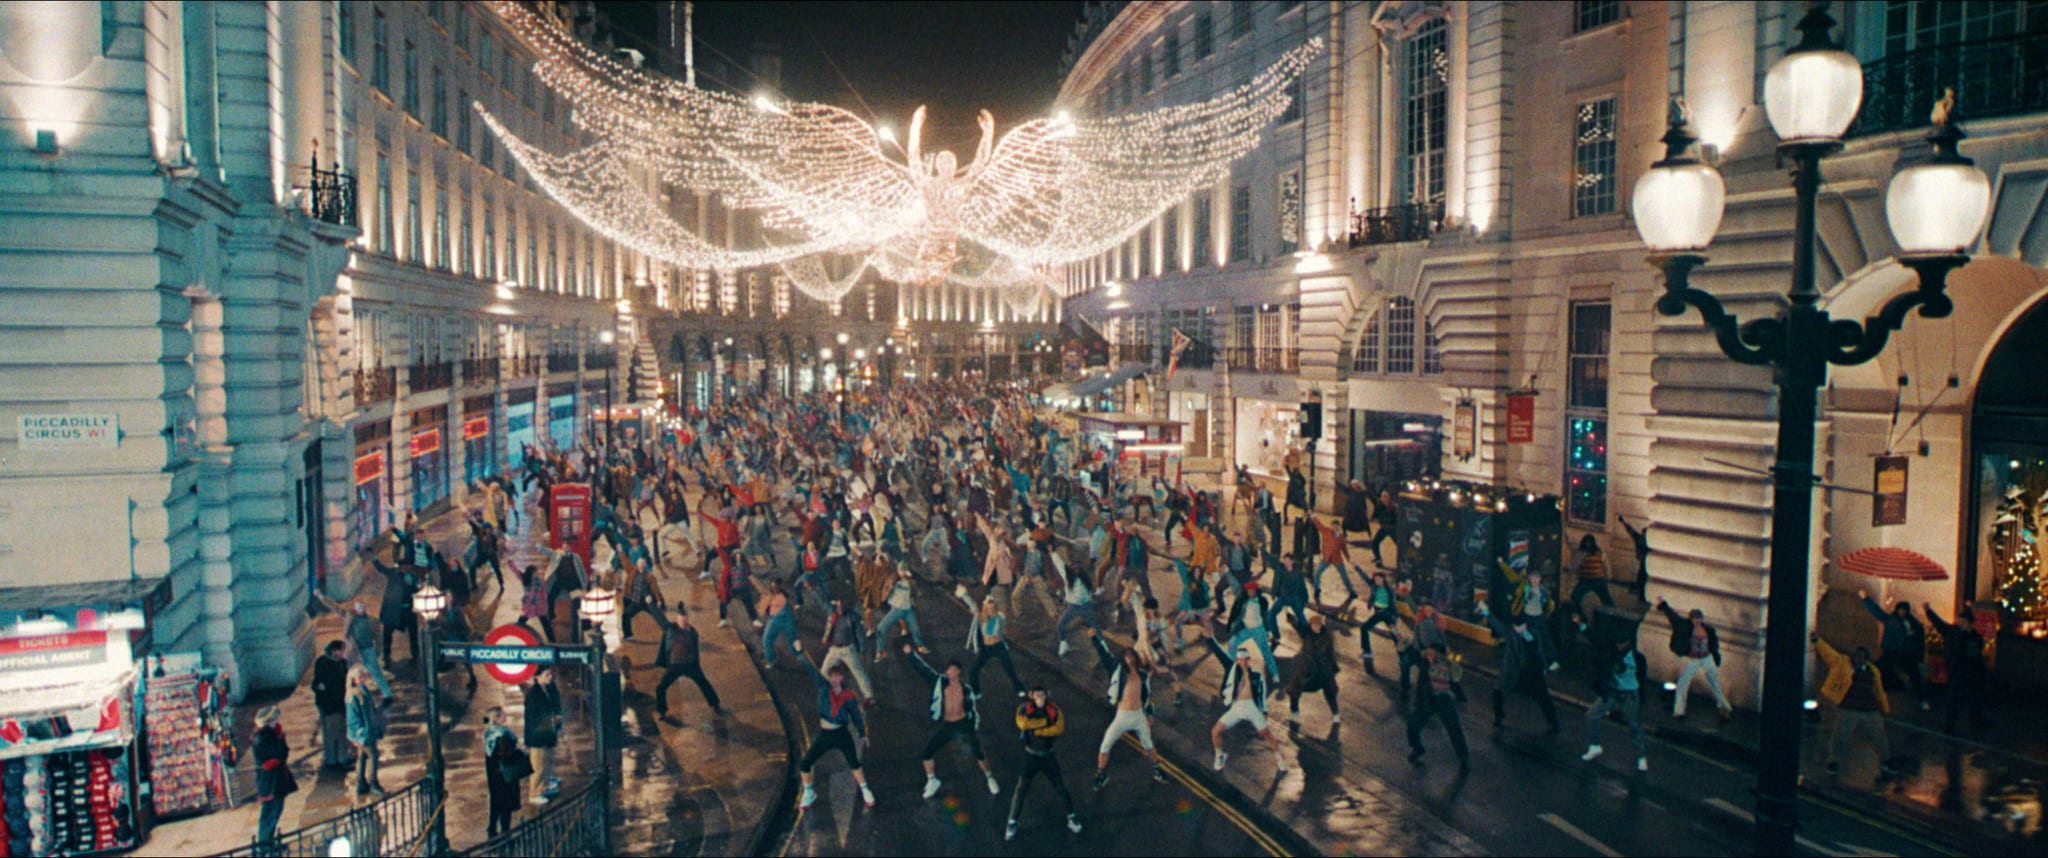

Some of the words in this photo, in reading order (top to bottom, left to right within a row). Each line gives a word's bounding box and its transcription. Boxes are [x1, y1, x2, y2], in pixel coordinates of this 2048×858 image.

[24, 417, 109, 427] PICCADILLY
[25, 429, 81, 439] CIRCUS
[88, 429, 106, 438] W1
[19, 636, 69, 649] TICKETS
[50, 650, 90, 662] AGENT
[440, 648, 465, 656] PUBLIC
[470, 649, 519, 659] PICCADILLY
[521, 649, 553, 660] CIRCUS
